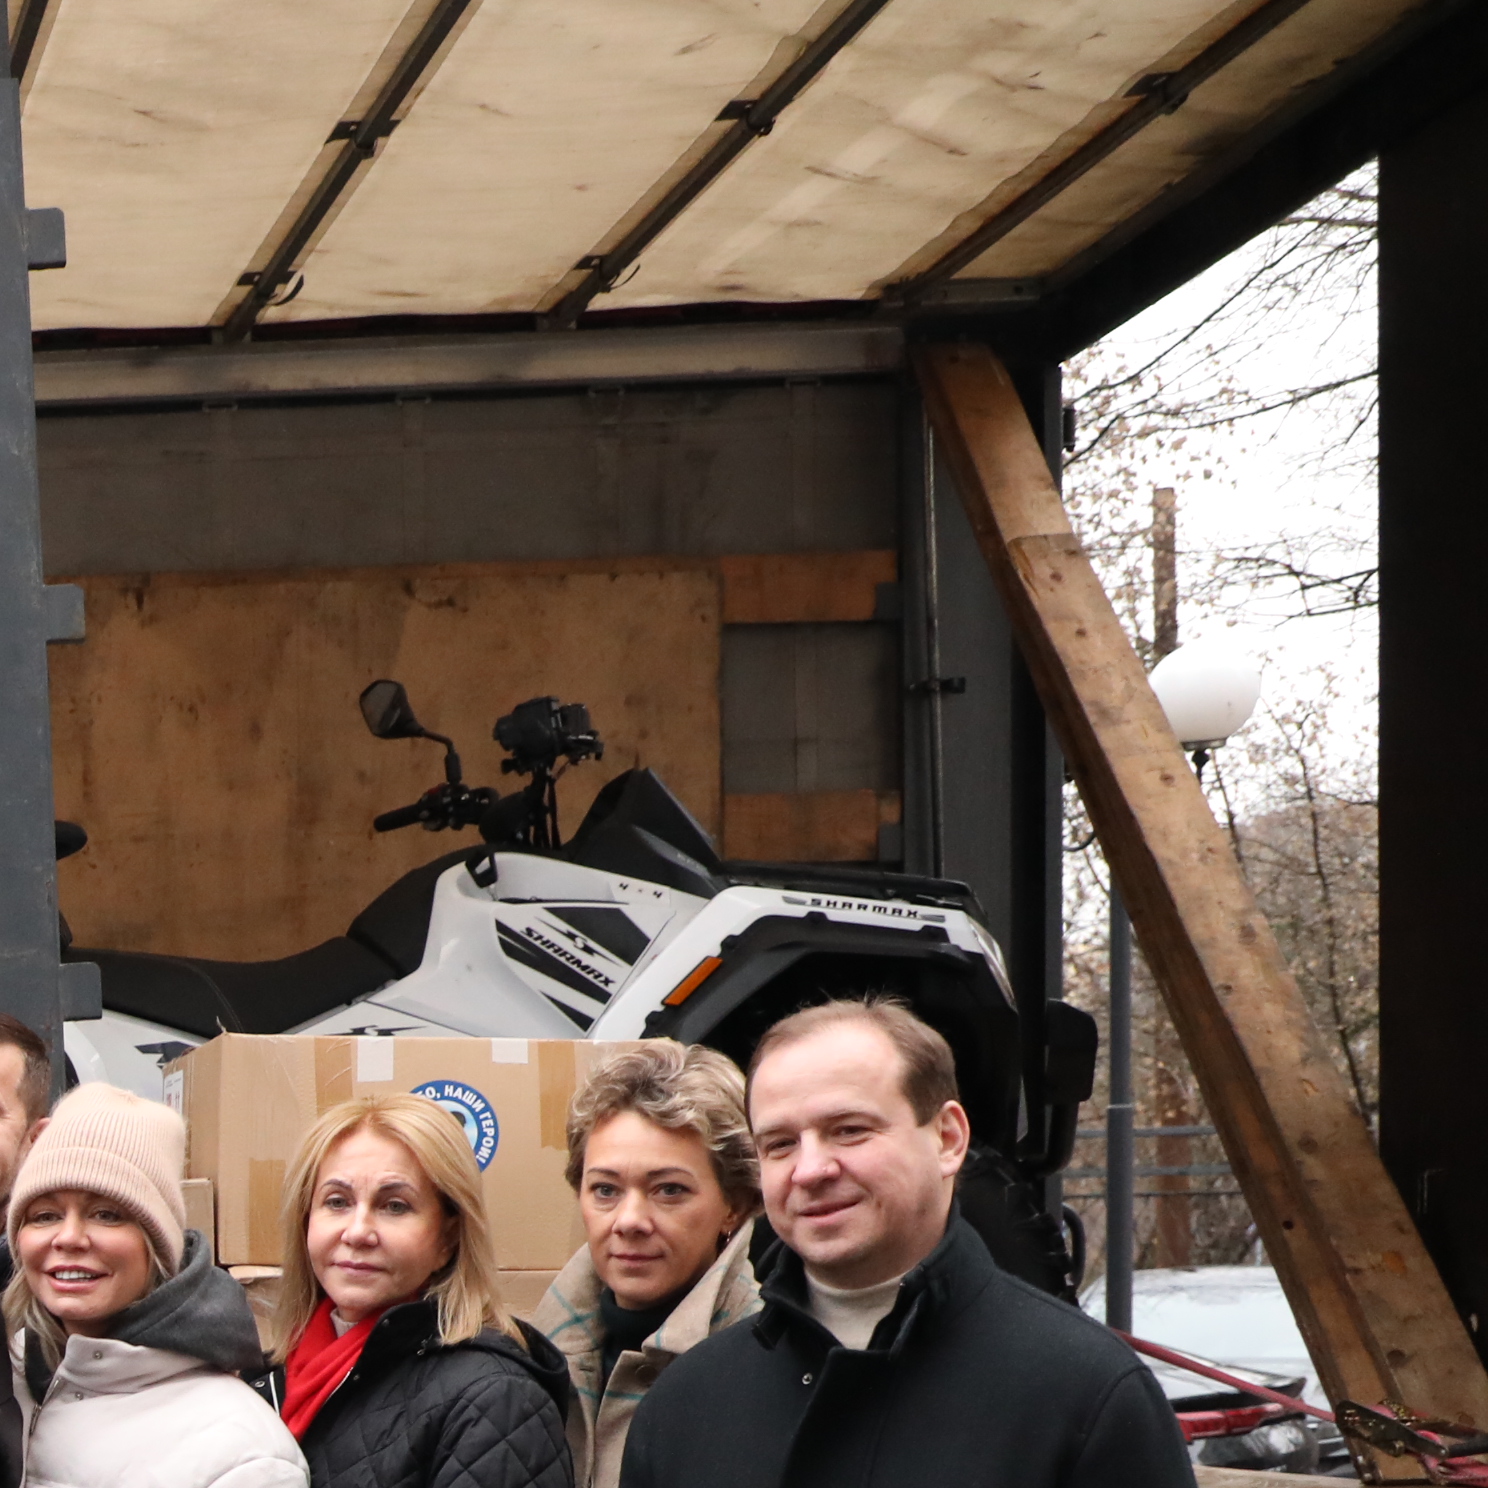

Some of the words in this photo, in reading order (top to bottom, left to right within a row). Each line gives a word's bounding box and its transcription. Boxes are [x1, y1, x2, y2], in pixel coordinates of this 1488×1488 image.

[811, 898, 918, 919] SHARMAX
[521, 926, 617, 988] SHARMAX
[444, 1085, 486, 1113] НАШИ
[476, 1111, 495, 1164] ГЕРОИ!
